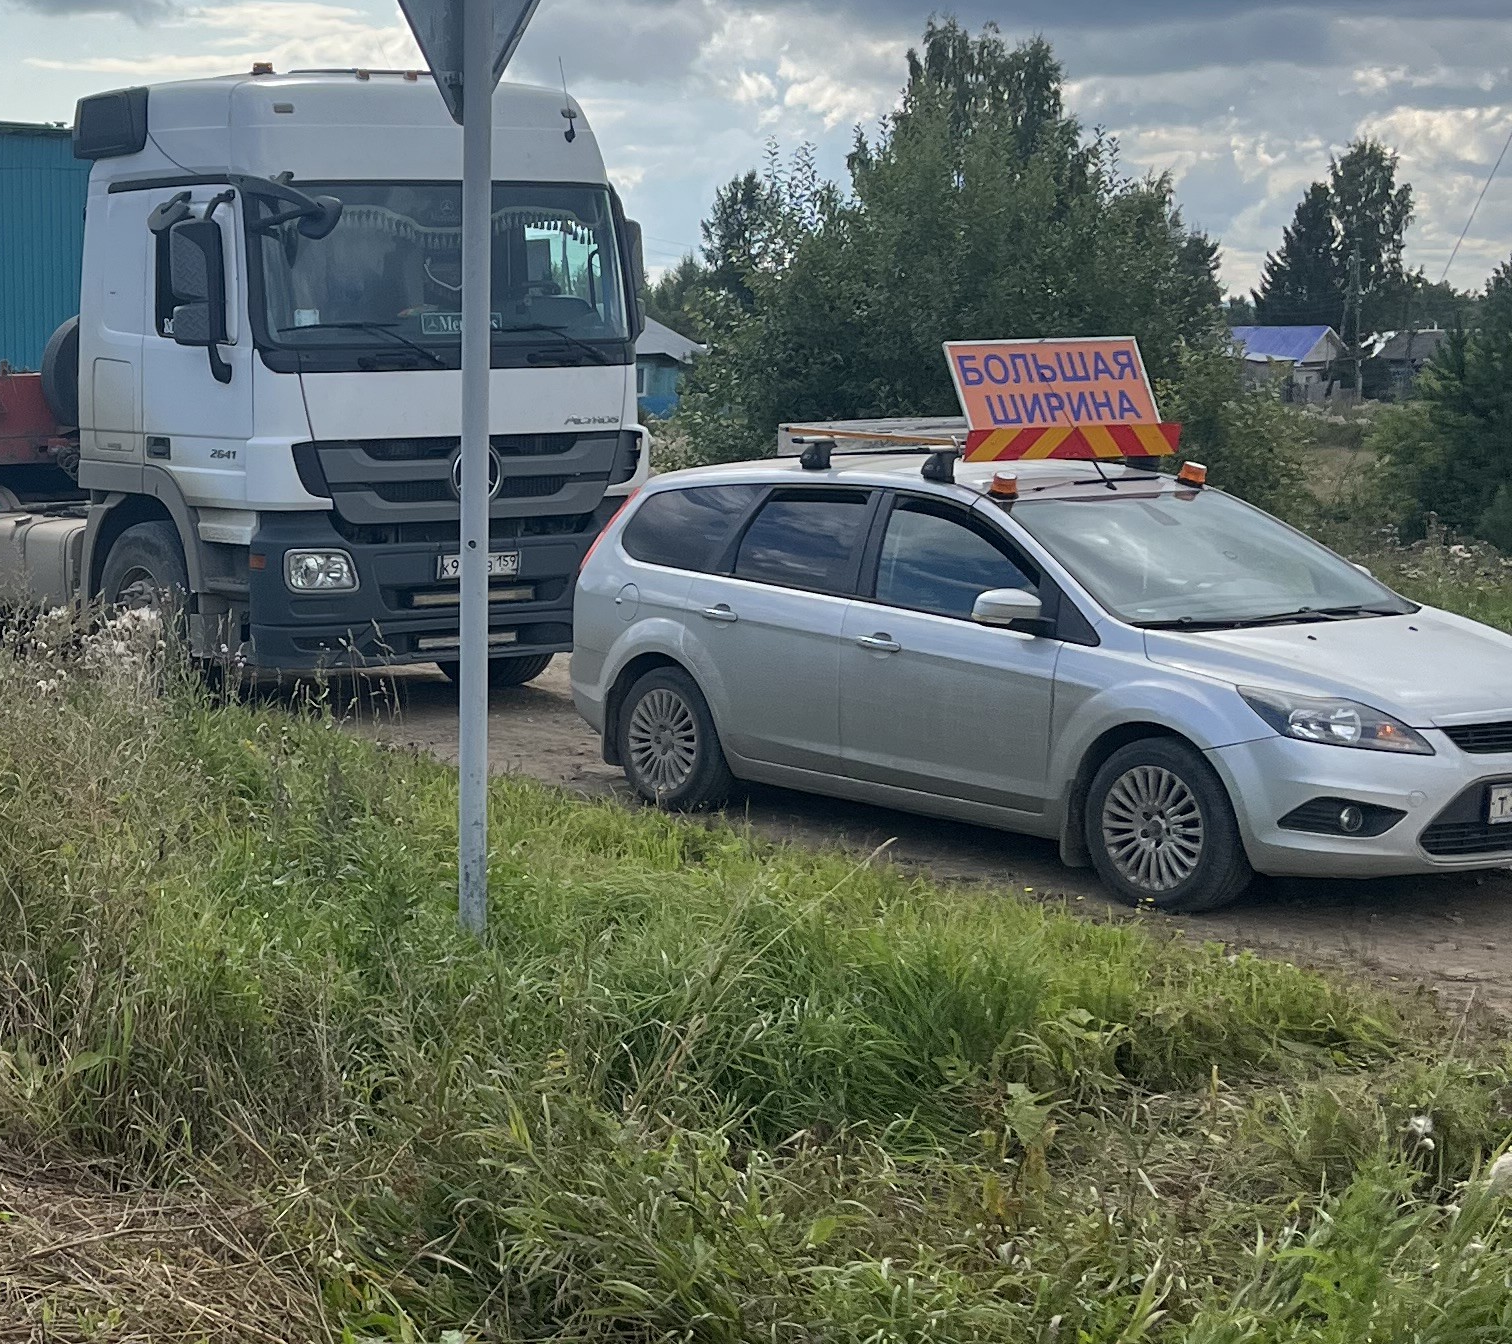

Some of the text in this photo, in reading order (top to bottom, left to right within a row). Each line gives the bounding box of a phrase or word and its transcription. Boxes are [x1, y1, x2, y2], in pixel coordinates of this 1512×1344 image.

[957, 350, 1138, 386] БОЛЬШАЯ
[985, 389, 1143, 425] ШИРИНА
[210, 449, 236, 459] 2641
[496, 555, 516, 568] 159
